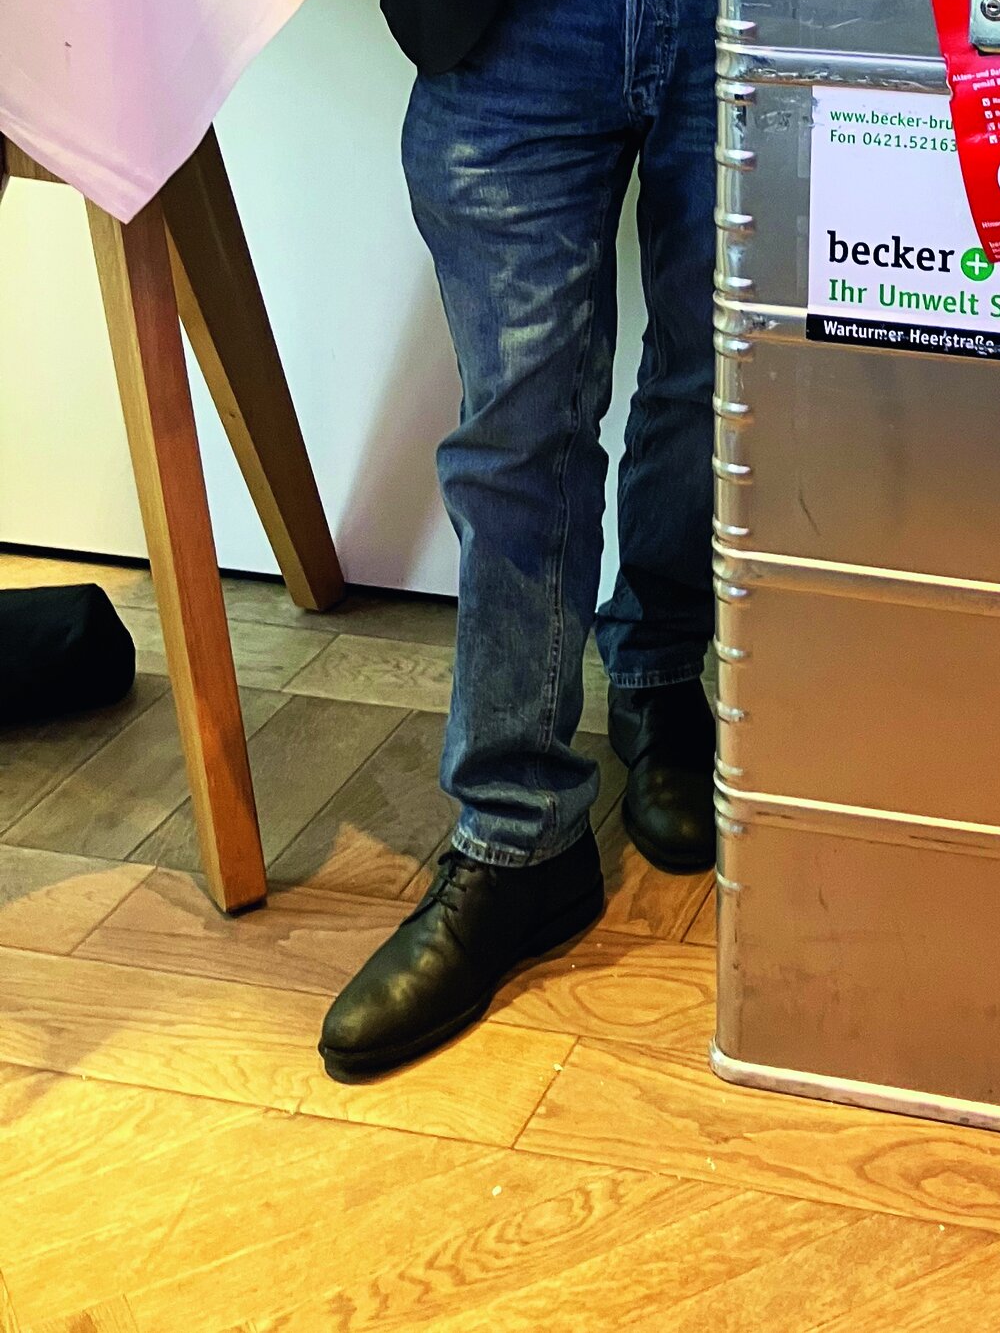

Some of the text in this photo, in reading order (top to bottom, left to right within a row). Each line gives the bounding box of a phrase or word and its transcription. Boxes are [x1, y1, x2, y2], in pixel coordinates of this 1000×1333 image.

[976, 71, 989, 79] und
[830, 110, 954, 130] www.becker-bru
[830, 129, 855, 144] Fon
[827, 230, 955, 273] becker
[829, 279, 867, 304] Ihr
[879, 283, 979, 316] Umwelt
[823, 320, 904, 343] Warturmer
[909, 329, 994, 353] Heerstraße
